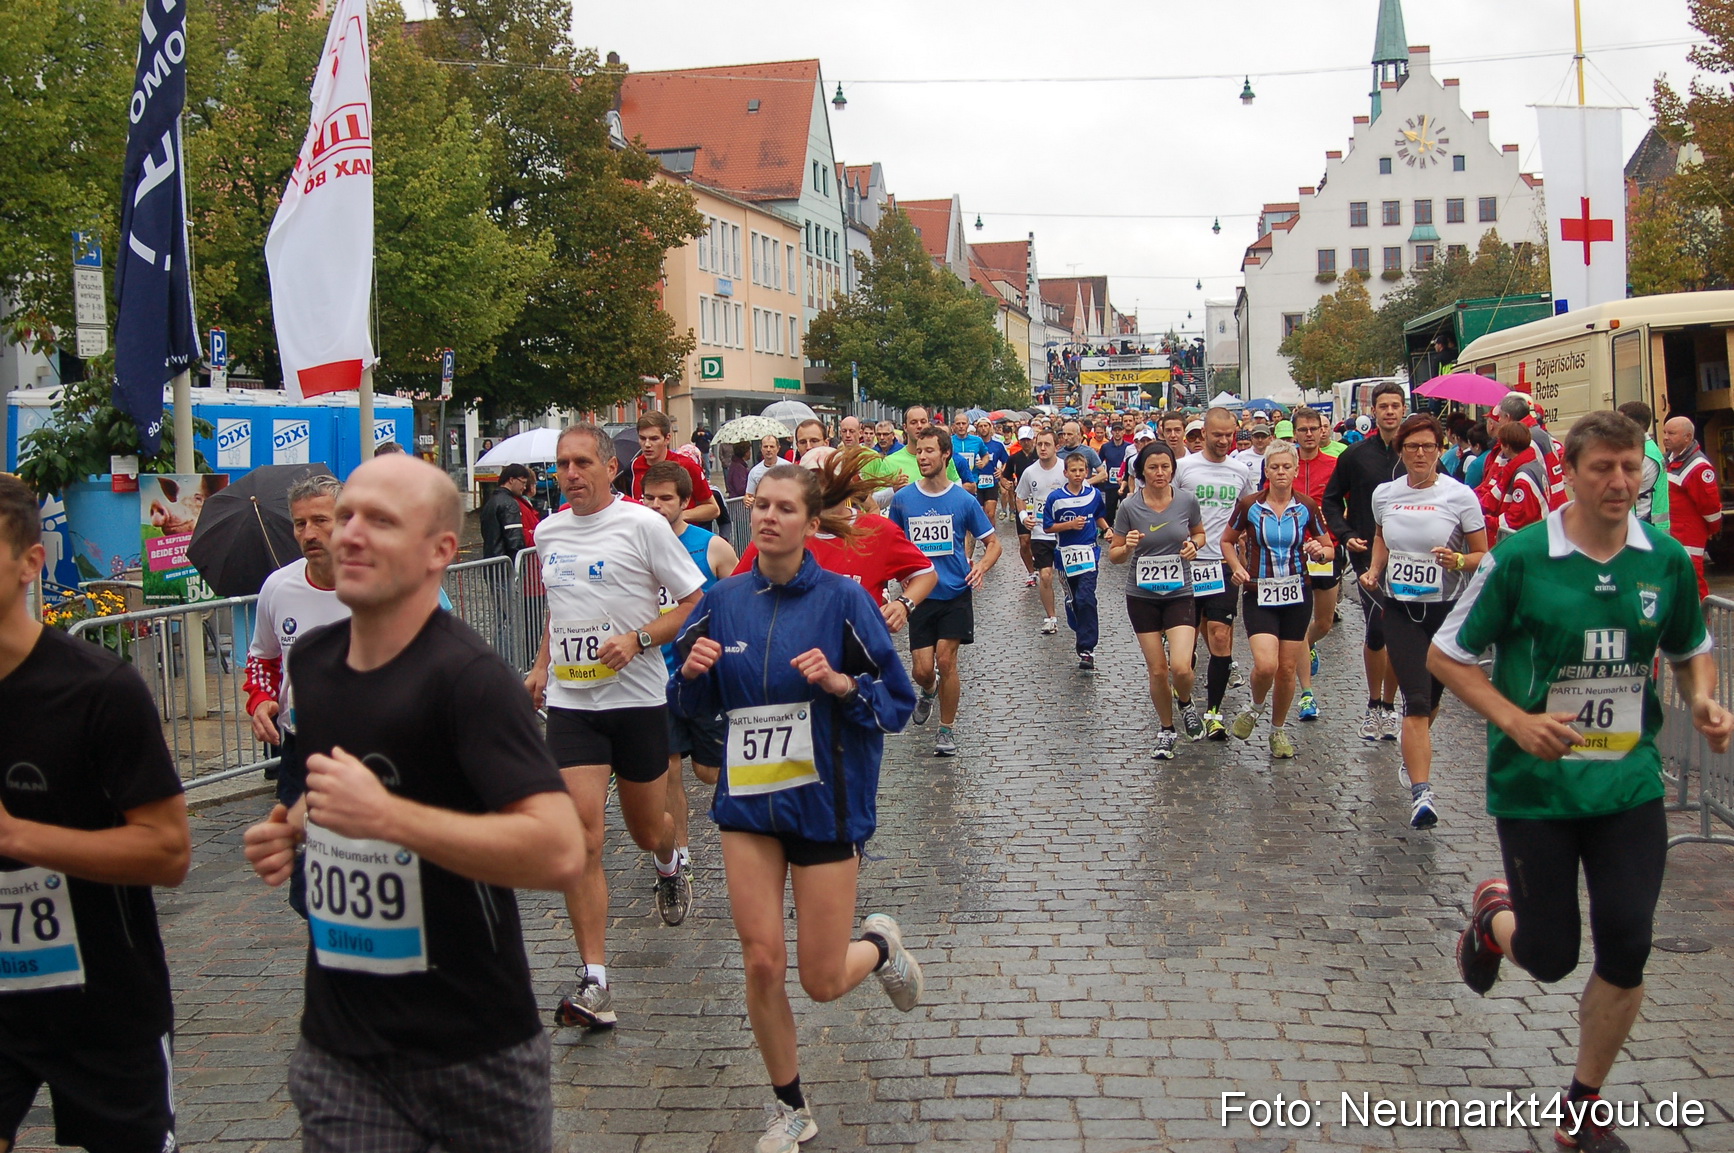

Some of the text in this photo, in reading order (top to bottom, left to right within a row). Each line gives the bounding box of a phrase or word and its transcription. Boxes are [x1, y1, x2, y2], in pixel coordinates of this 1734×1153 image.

[214, 335, 223, 362] P
[704, 359, 720, 376] D
[1536, 351, 1586, 380] Bayerisches
[1109, 373, 1140, 382] START
[1535, 381, 1560, 400] Rotes
[1544, 408, 1559, 423] euz
[913, 525, 949, 541] 2430
[151, 547, 174, 559] BEIDE
[920, 543, 943, 551] Gerhard
[1065, 551, 1091, 565] 2411
[1141, 564, 1179, 581] 2212
[1193, 566, 1218, 582] 641
[1392, 562, 1437, 584] 2950
[1194, 582, 1213, 592] Daniel
[1263, 585, 1299, 602] 2198
[1594, 584, 1616, 592] erima
[566, 625, 599, 634] Neumarkt
[560, 635, 599, 662] 178
[568, 668, 597, 679] Robert
[1558, 661, 1650, 680] HEIM & HAUS
[1551, 685, 1628, 695] PARTL Neumarkt
[730, 713, 794, 726] PARTL Neumarkt
[1576, 698, 1614, 729] 46
[743, 726, 793, 760] 577
[331, 846, 389, 865] Neumarkt
[0, 881, 39, 897] markt
[310, 860, 405, 921] 3039
[0, 897, 61, 945] 78
[328, 928, 374, 953] Silvio
[0, 957, 39, 974] bias
